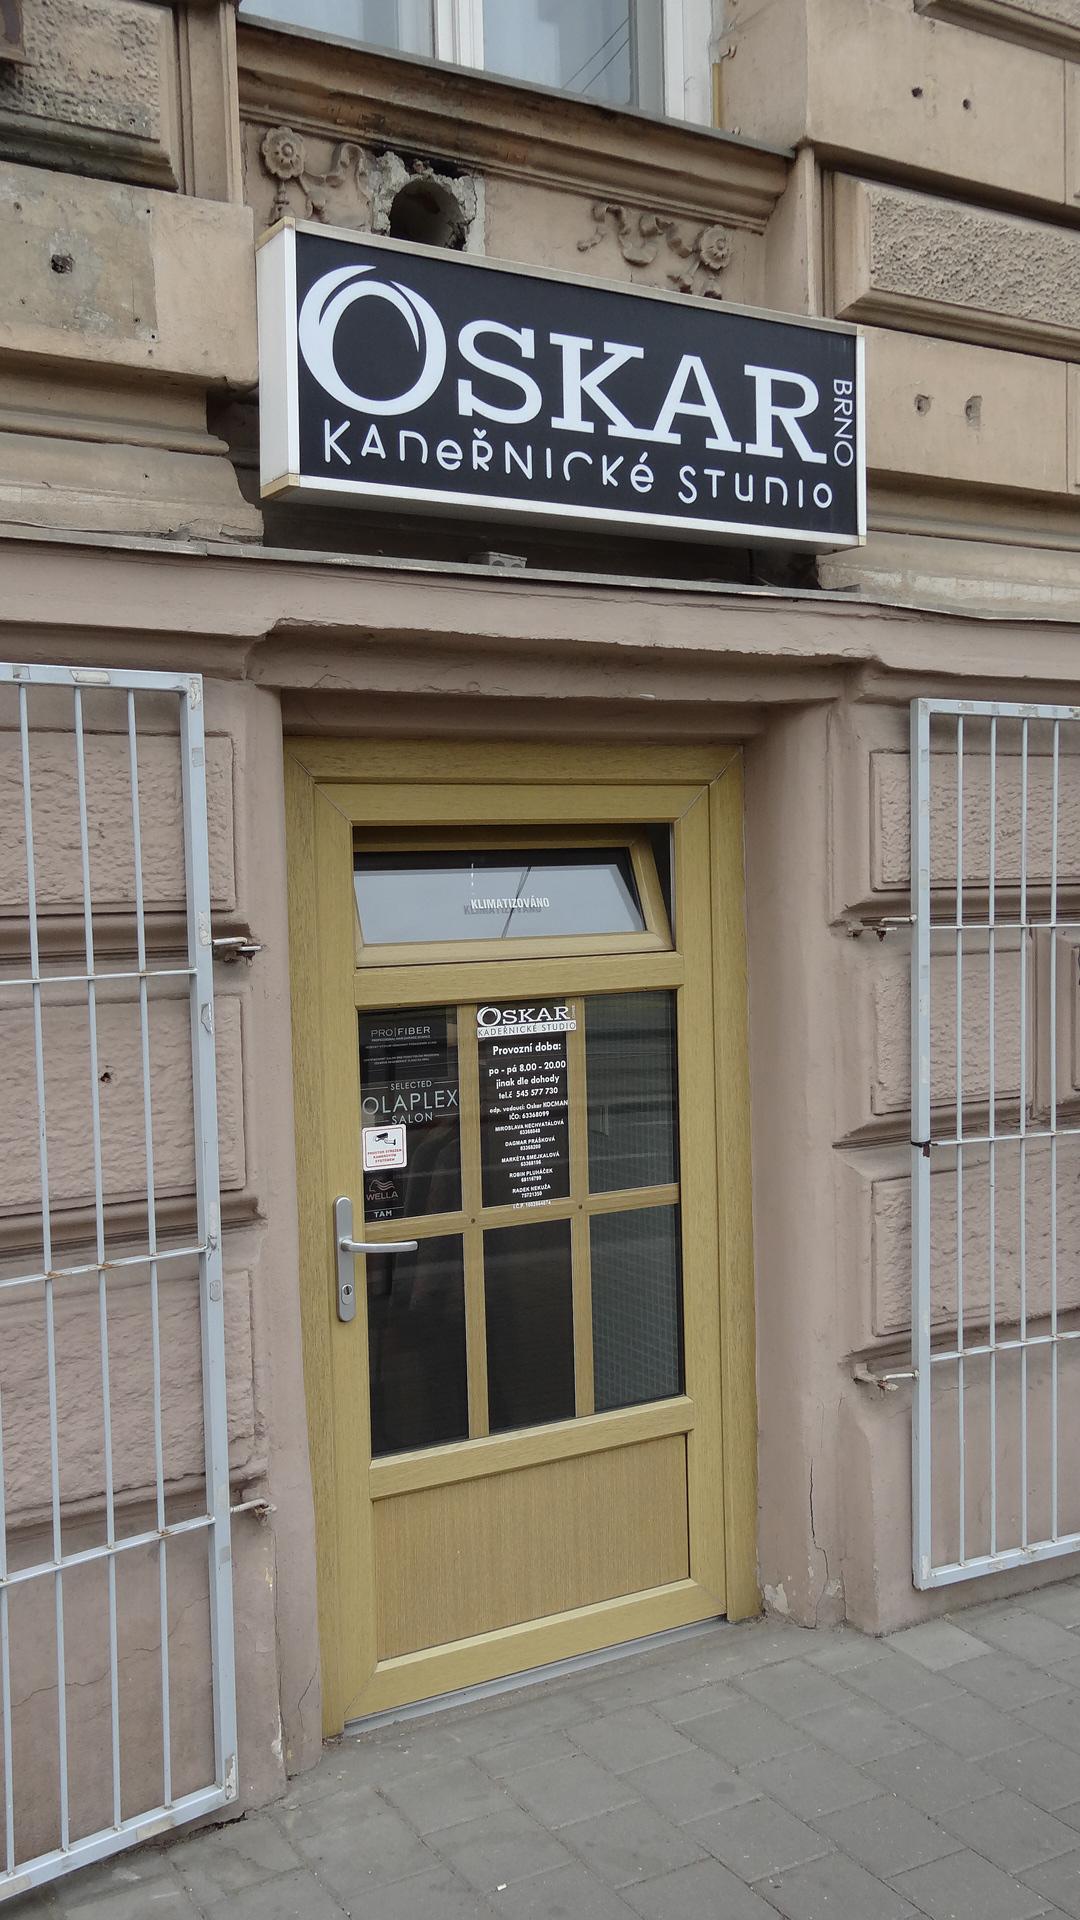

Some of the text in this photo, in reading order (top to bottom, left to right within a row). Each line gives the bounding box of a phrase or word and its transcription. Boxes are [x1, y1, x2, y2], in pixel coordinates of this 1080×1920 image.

[298, 264, 827, 464] OSKAR
[833, 379, 853, 469] BRNO
[470, 895, 550, 910] KLIMATIZOVÁNO
[477, 1006, 570, 1027] OSKAR
[478, 1022, 576, 1037] KADEŘNICKÉ STUDIO
[492, 1041, 561, 1055] Provozní doba:
[489, 1068, 499, 1077] po
[507, 1064, 517, 1075] pá
[519, 1063, 537, 1072] 8.00
[544, 1060, 566, 1070] 20.00
[390, 1080, 432, 1091] SELECTED
[496, 1074, 560, 1089] jinak dle dohody
[516, 1090, 529, 1098] 545
[531, 1088, 544, 1096] 577
[545, 1087, 559, 1095] 730
[362, 1089, 458, 1115] OLAPLEX
[392, 1112, 433, 1125] SALON
[366, 1191, 398, 1201] WELLA
[374, 1210, 392, 1218] TAM
